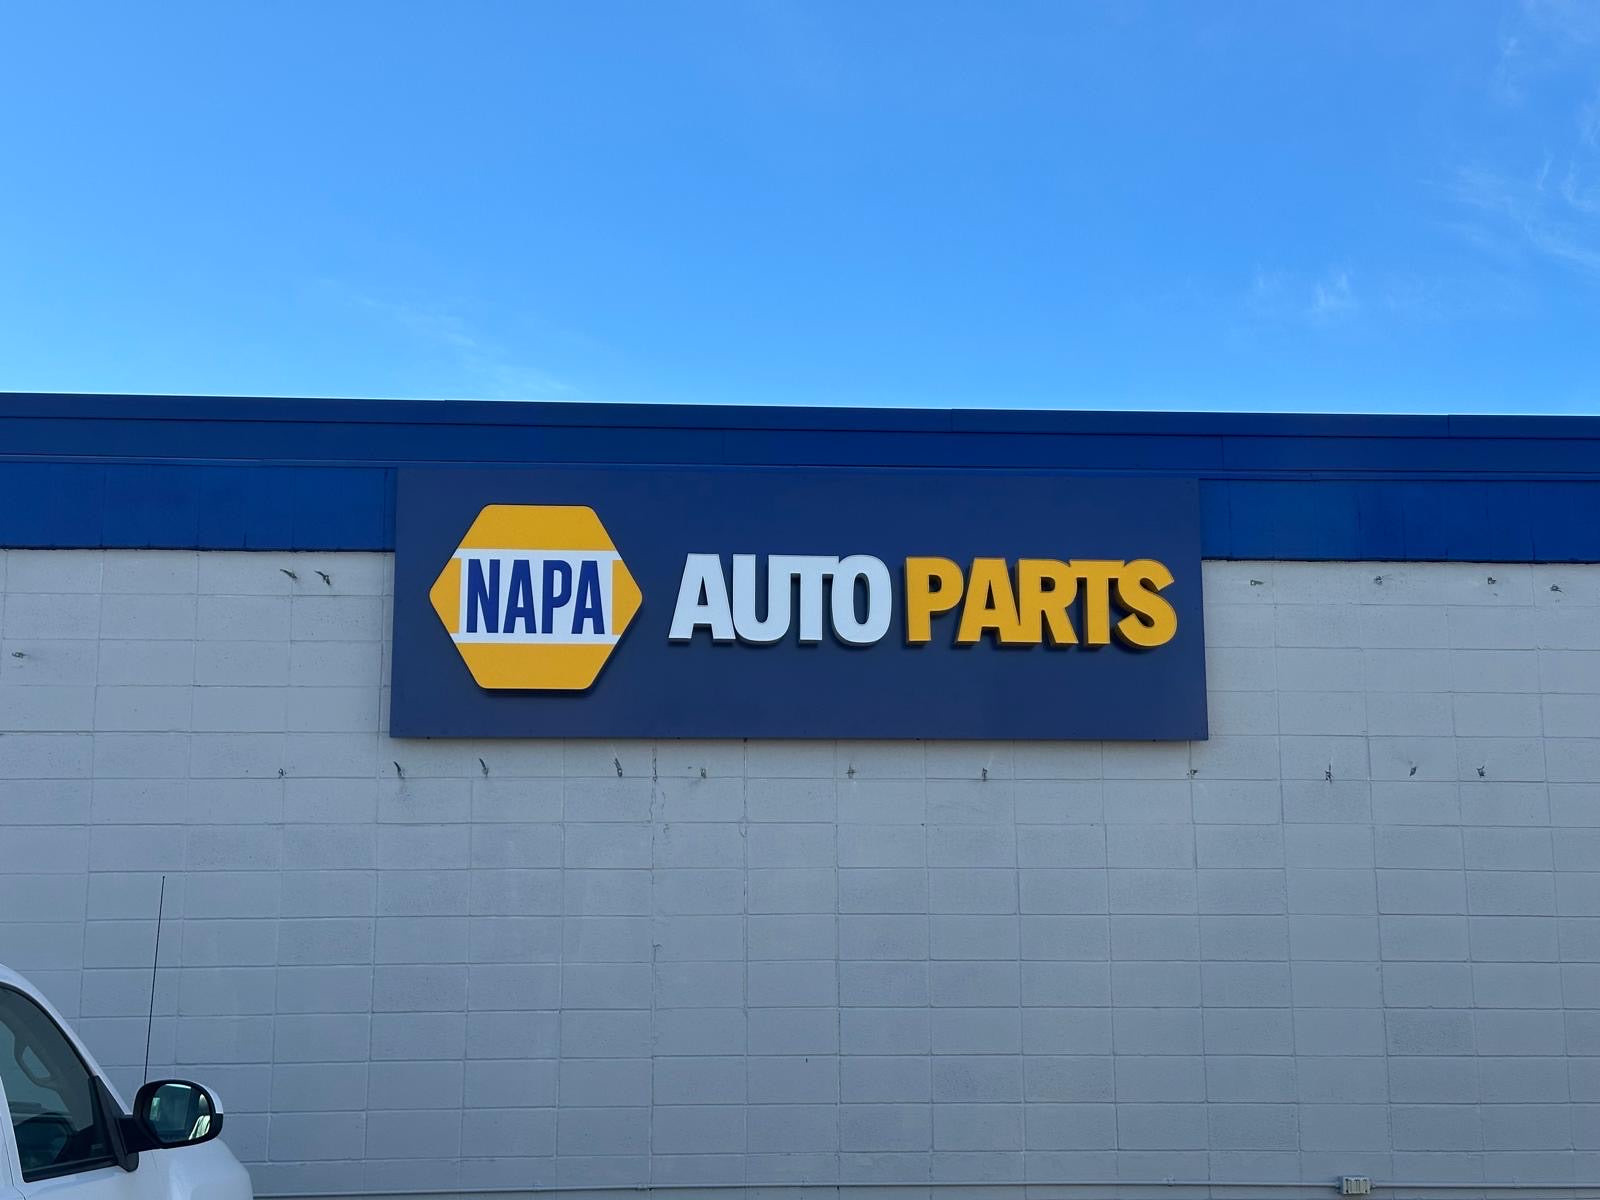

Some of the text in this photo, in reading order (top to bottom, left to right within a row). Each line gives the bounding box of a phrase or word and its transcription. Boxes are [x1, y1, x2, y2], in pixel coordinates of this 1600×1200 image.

[466, 553, 1178, 648] NAPA AUTO PARTS
